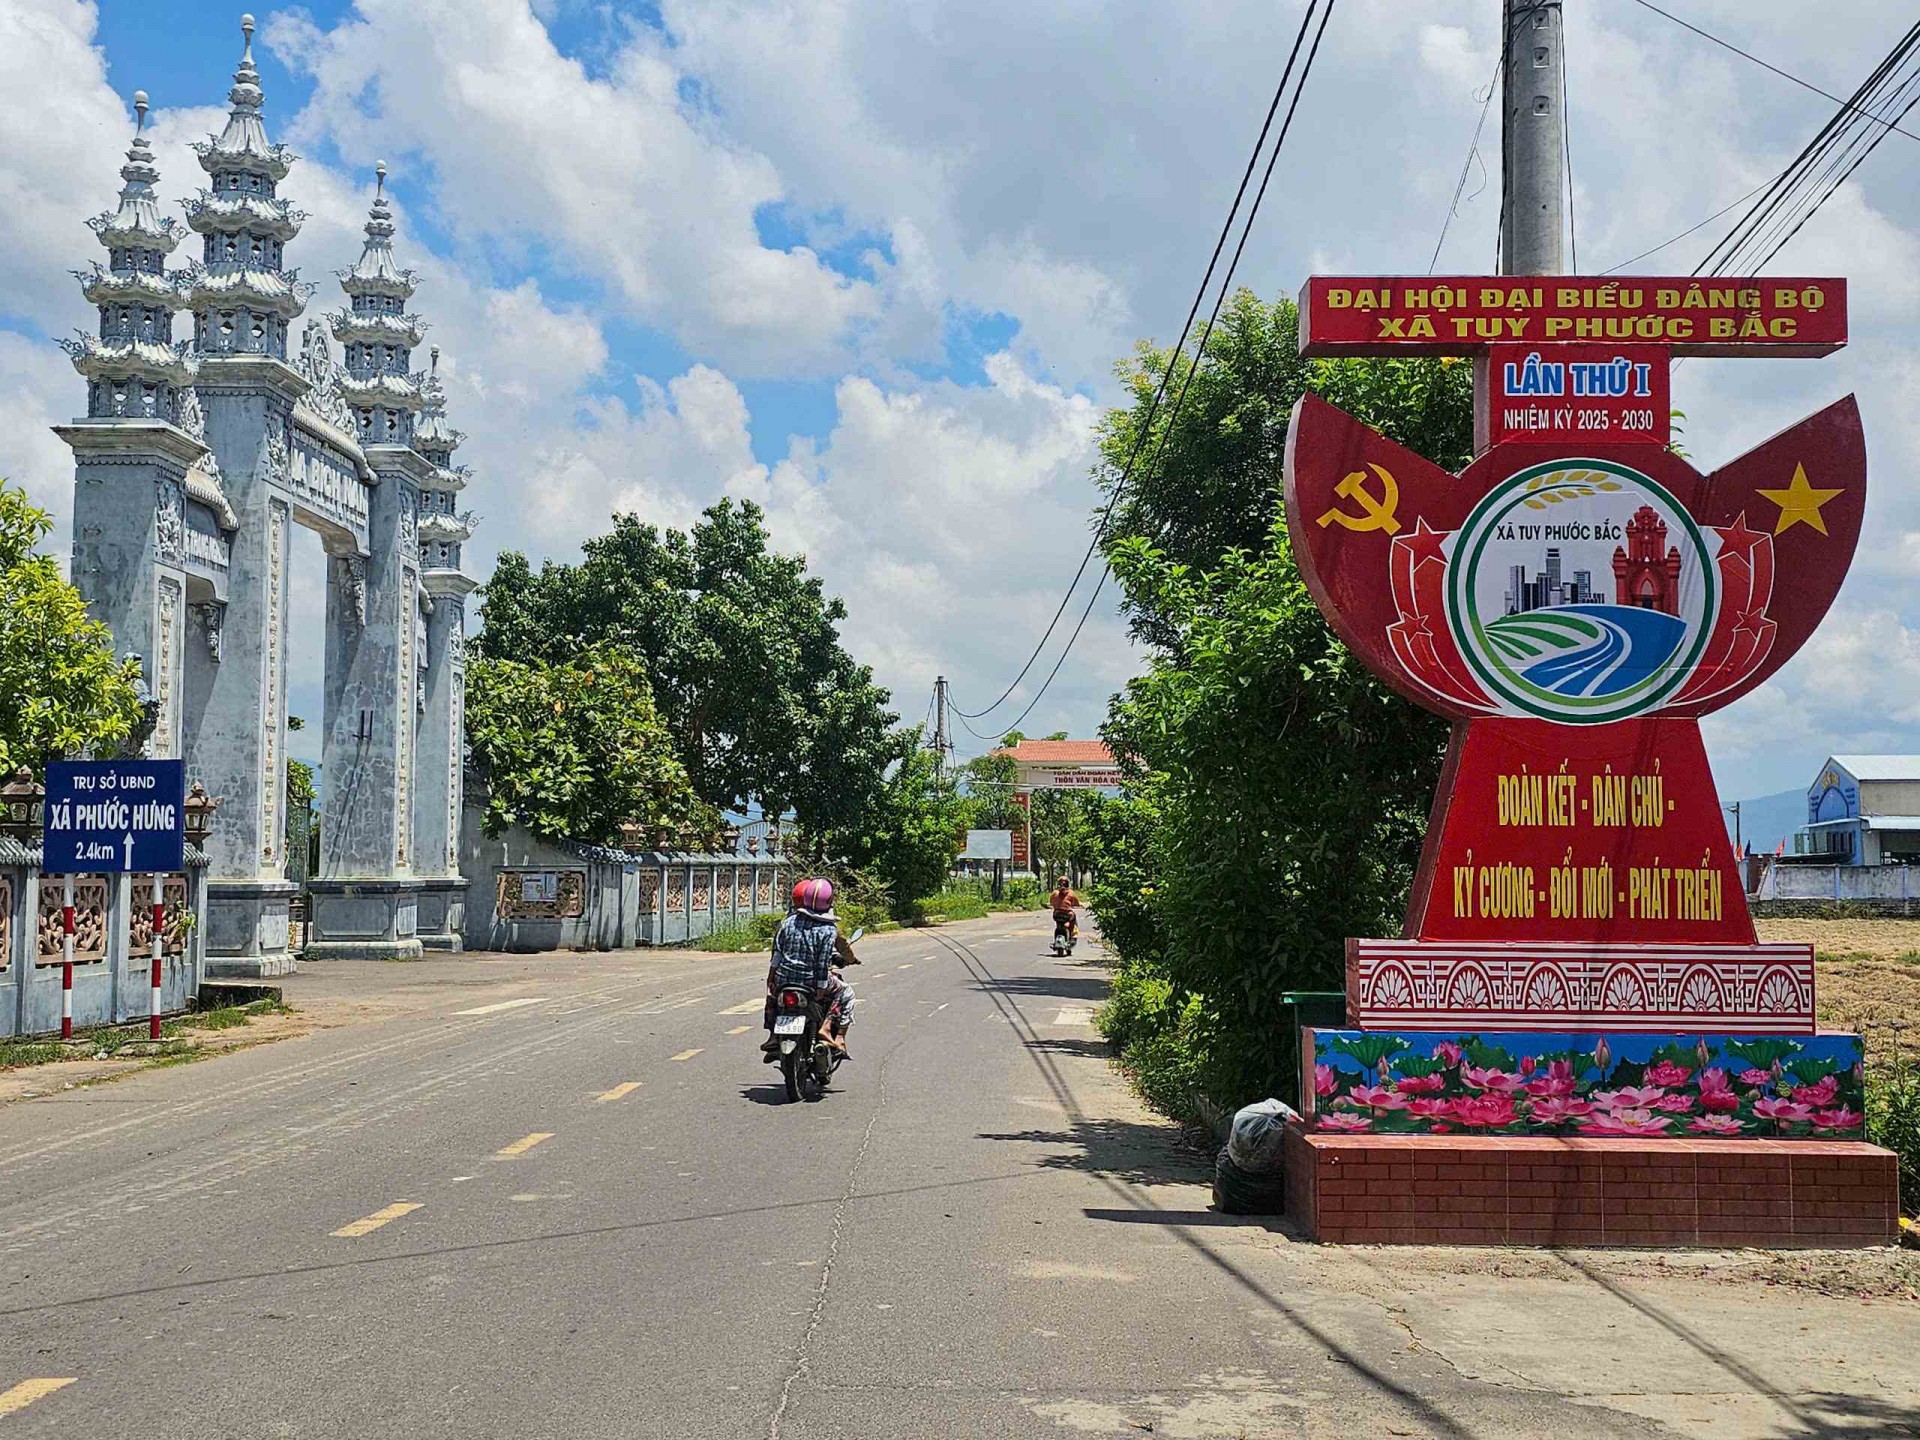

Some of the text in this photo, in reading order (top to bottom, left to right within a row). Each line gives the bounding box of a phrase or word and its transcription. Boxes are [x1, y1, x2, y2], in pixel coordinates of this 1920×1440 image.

[1328, 281, 1825, 312] ĐẠI HỘI ĐẠI BIỂU ĐẢNG BỘ
[1378, 311, 1797, 338] XÃ TUY PHƯỚC BẮC
[1504, 353, 1652, 397] LẦN THỨ I
[1504, 404, 1551, 434] NHIỆM
[1554, 404, 1573, 430] KỲ
[1577, 411, 1609, 430] 2025
[1622, 410, 1653, 430] 2030
[1497, 519, 1622, 540] XÃ TUY PHƯỚC BẮC
[73, 769, 155, 792] TRỤ SỞ UBND
[1498, 764, 1543, 826] ĐOÀN
[1548, 758, 1576, 826] KẾT
[1593, 764, 1626, 826] DÂN
[1631, 757, 1663, 827] CHỦ
[50, 796, 175, 830] XÃ PHƯỚC HƯNG
[75, 841, 114, 860] 2.4km
[1453, 848, 1474, 918] KỶ
[1479, 861, 1534, 918] CƯƠNG
[1550, 846, 1577, 919] ĐỔI
[1583, 856, 1613, 919] MỚI
[1630, 857, 1670, 919] PHÁT
[1675, 847, 1722, 921] TRIỂN
